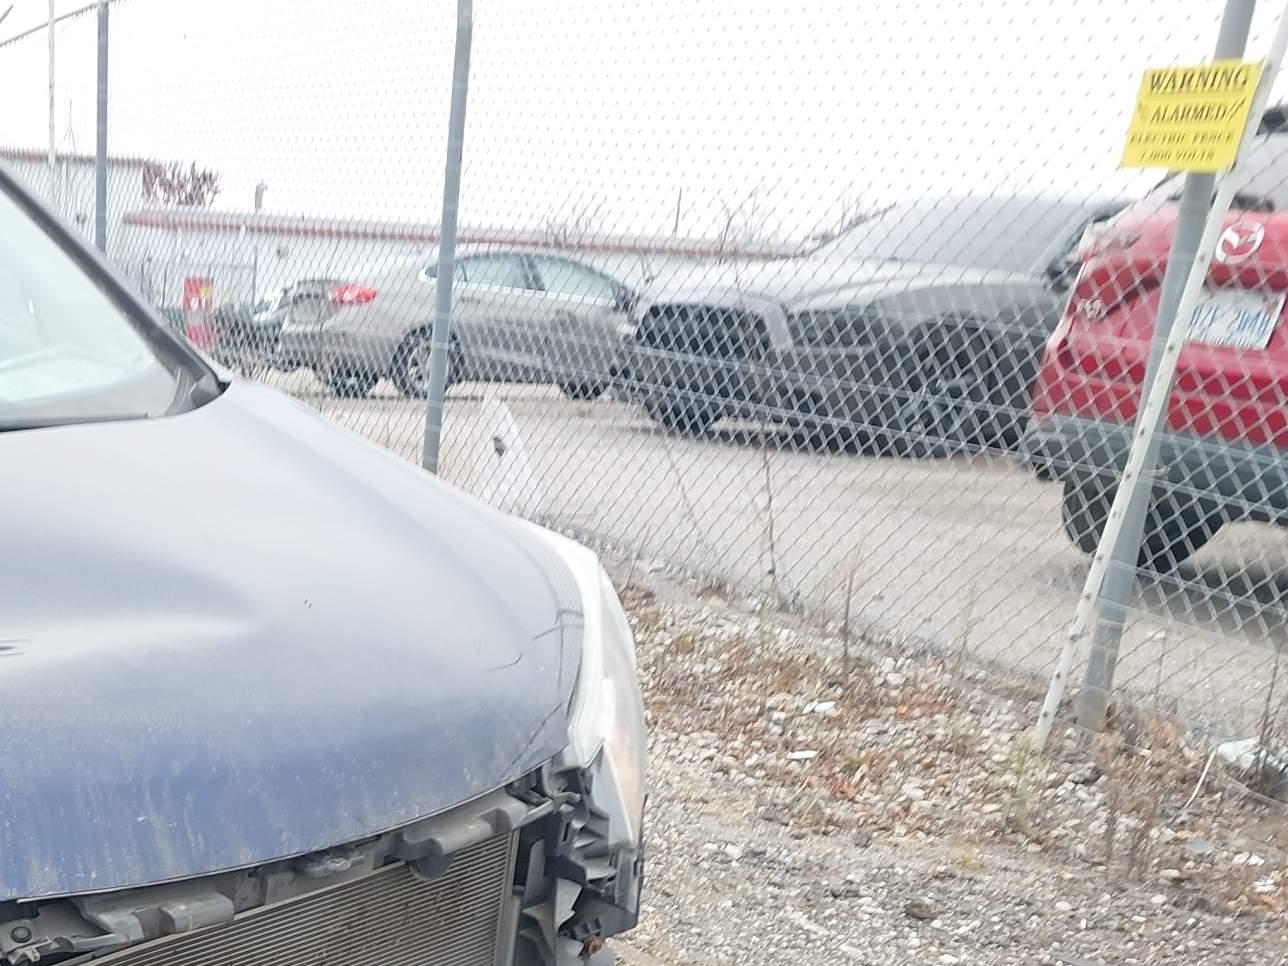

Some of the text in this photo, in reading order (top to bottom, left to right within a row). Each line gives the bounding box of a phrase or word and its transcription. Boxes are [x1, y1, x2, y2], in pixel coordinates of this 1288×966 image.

[1150, 68, 1250, 94] WARNING
[1129, 131, 1235, 144] ELECTRIC FENCE
[1175, 150, 1216, 161] VOLTS
